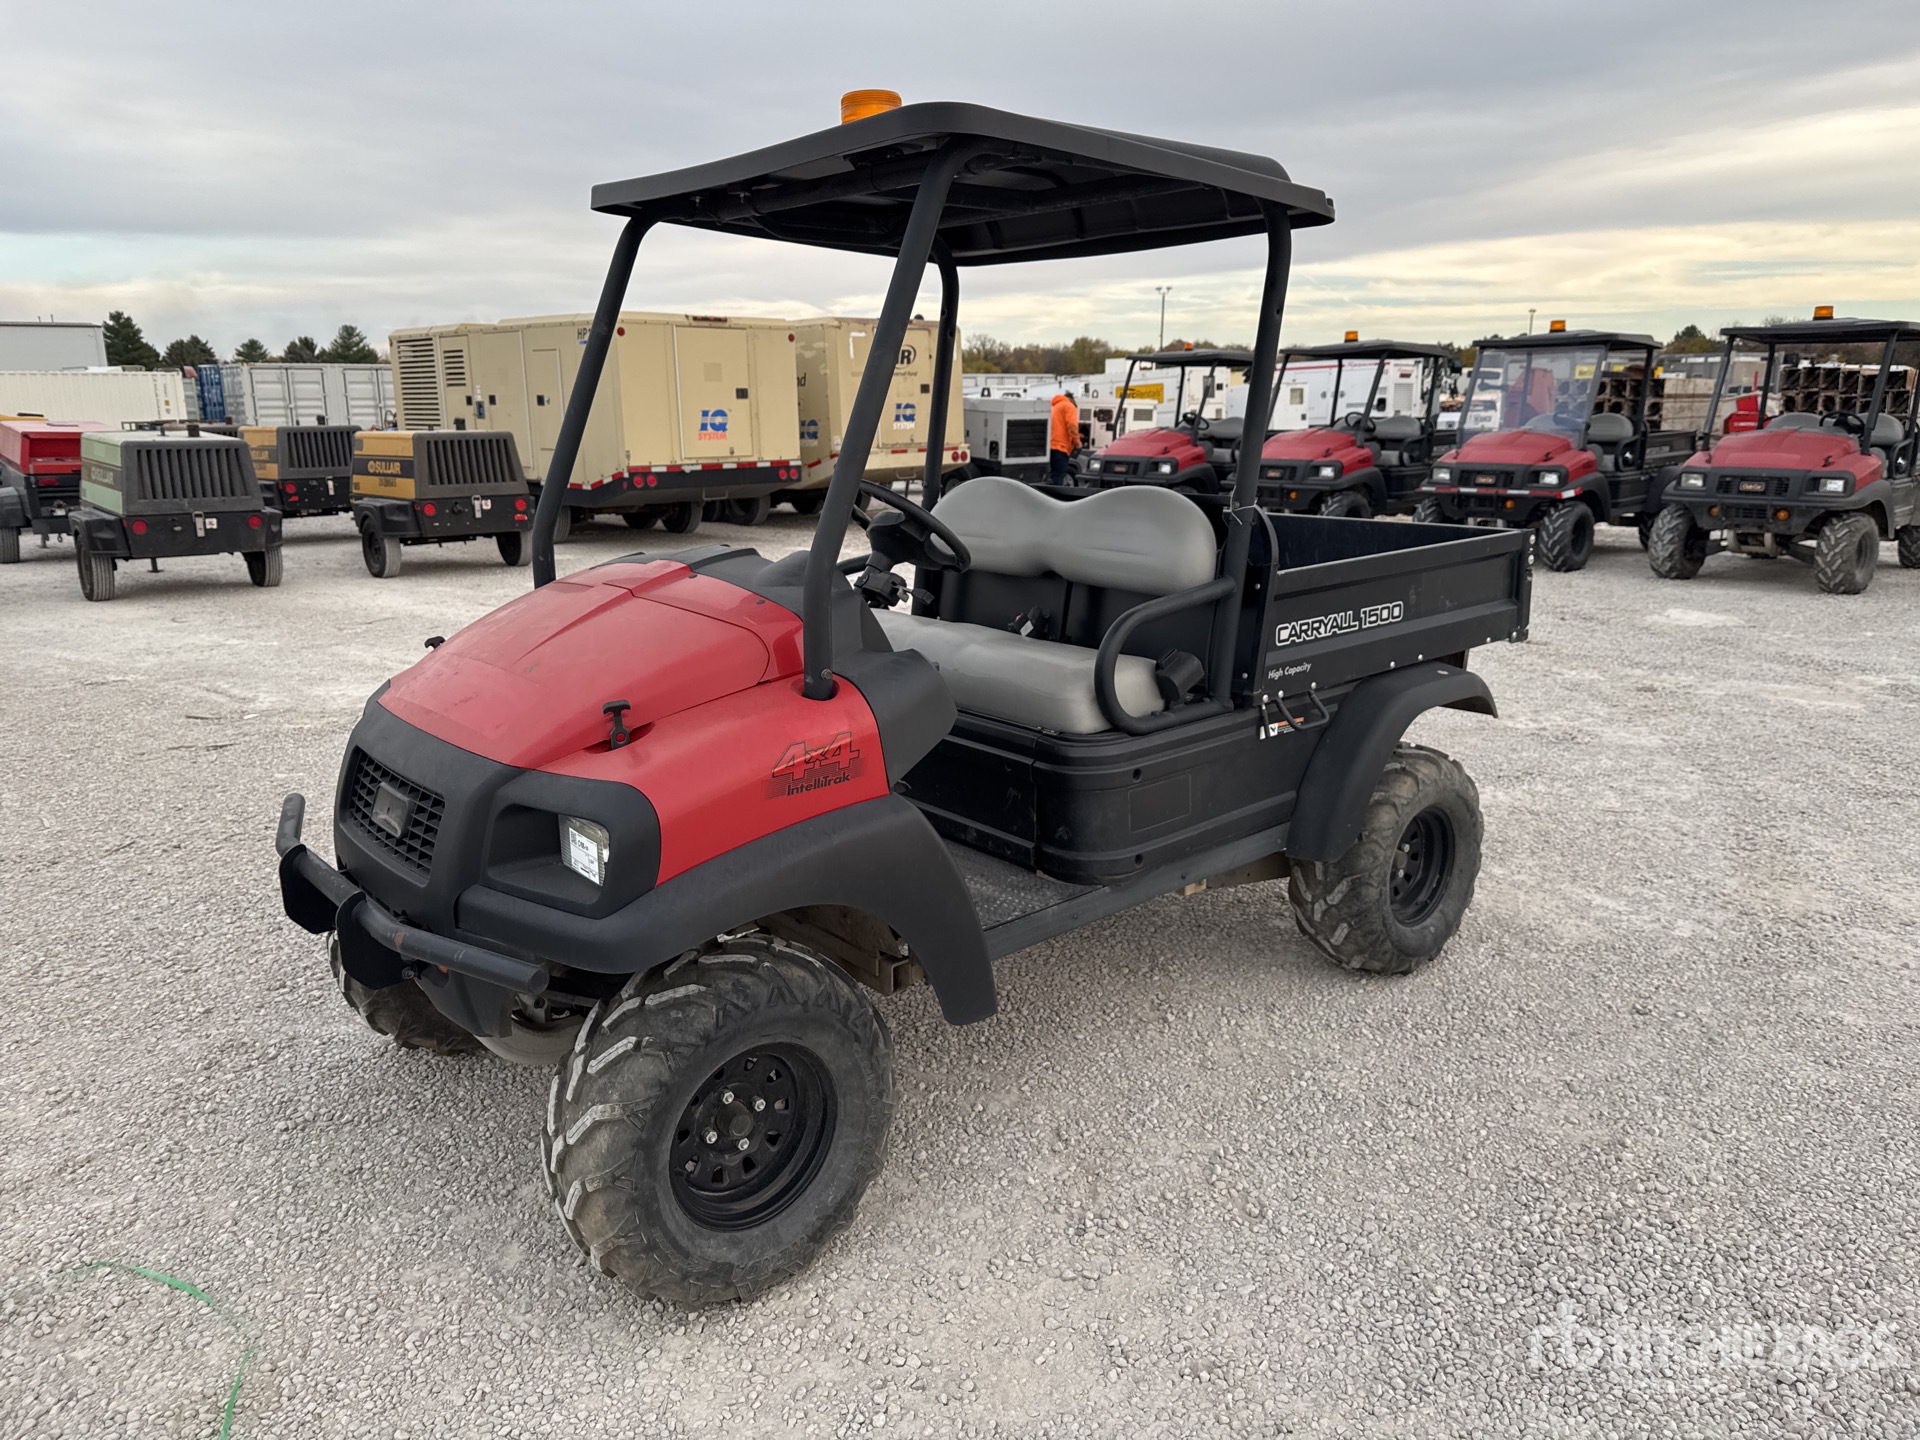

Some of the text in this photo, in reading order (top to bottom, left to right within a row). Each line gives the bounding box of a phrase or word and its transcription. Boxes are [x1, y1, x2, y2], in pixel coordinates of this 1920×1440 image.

[699, 409, 728, 432] IQ
[698, 431, 727, 441] SYSTEM
[374, 461, 401, 475] SULLAIR
[1276, 600, 1404, 646] CARRYALL 1500
[1268, 662, 1312, 680] High Capacity
[772, 731, 860, 782] 4x4
[786, 772, 851, 796] IntelliTrak
